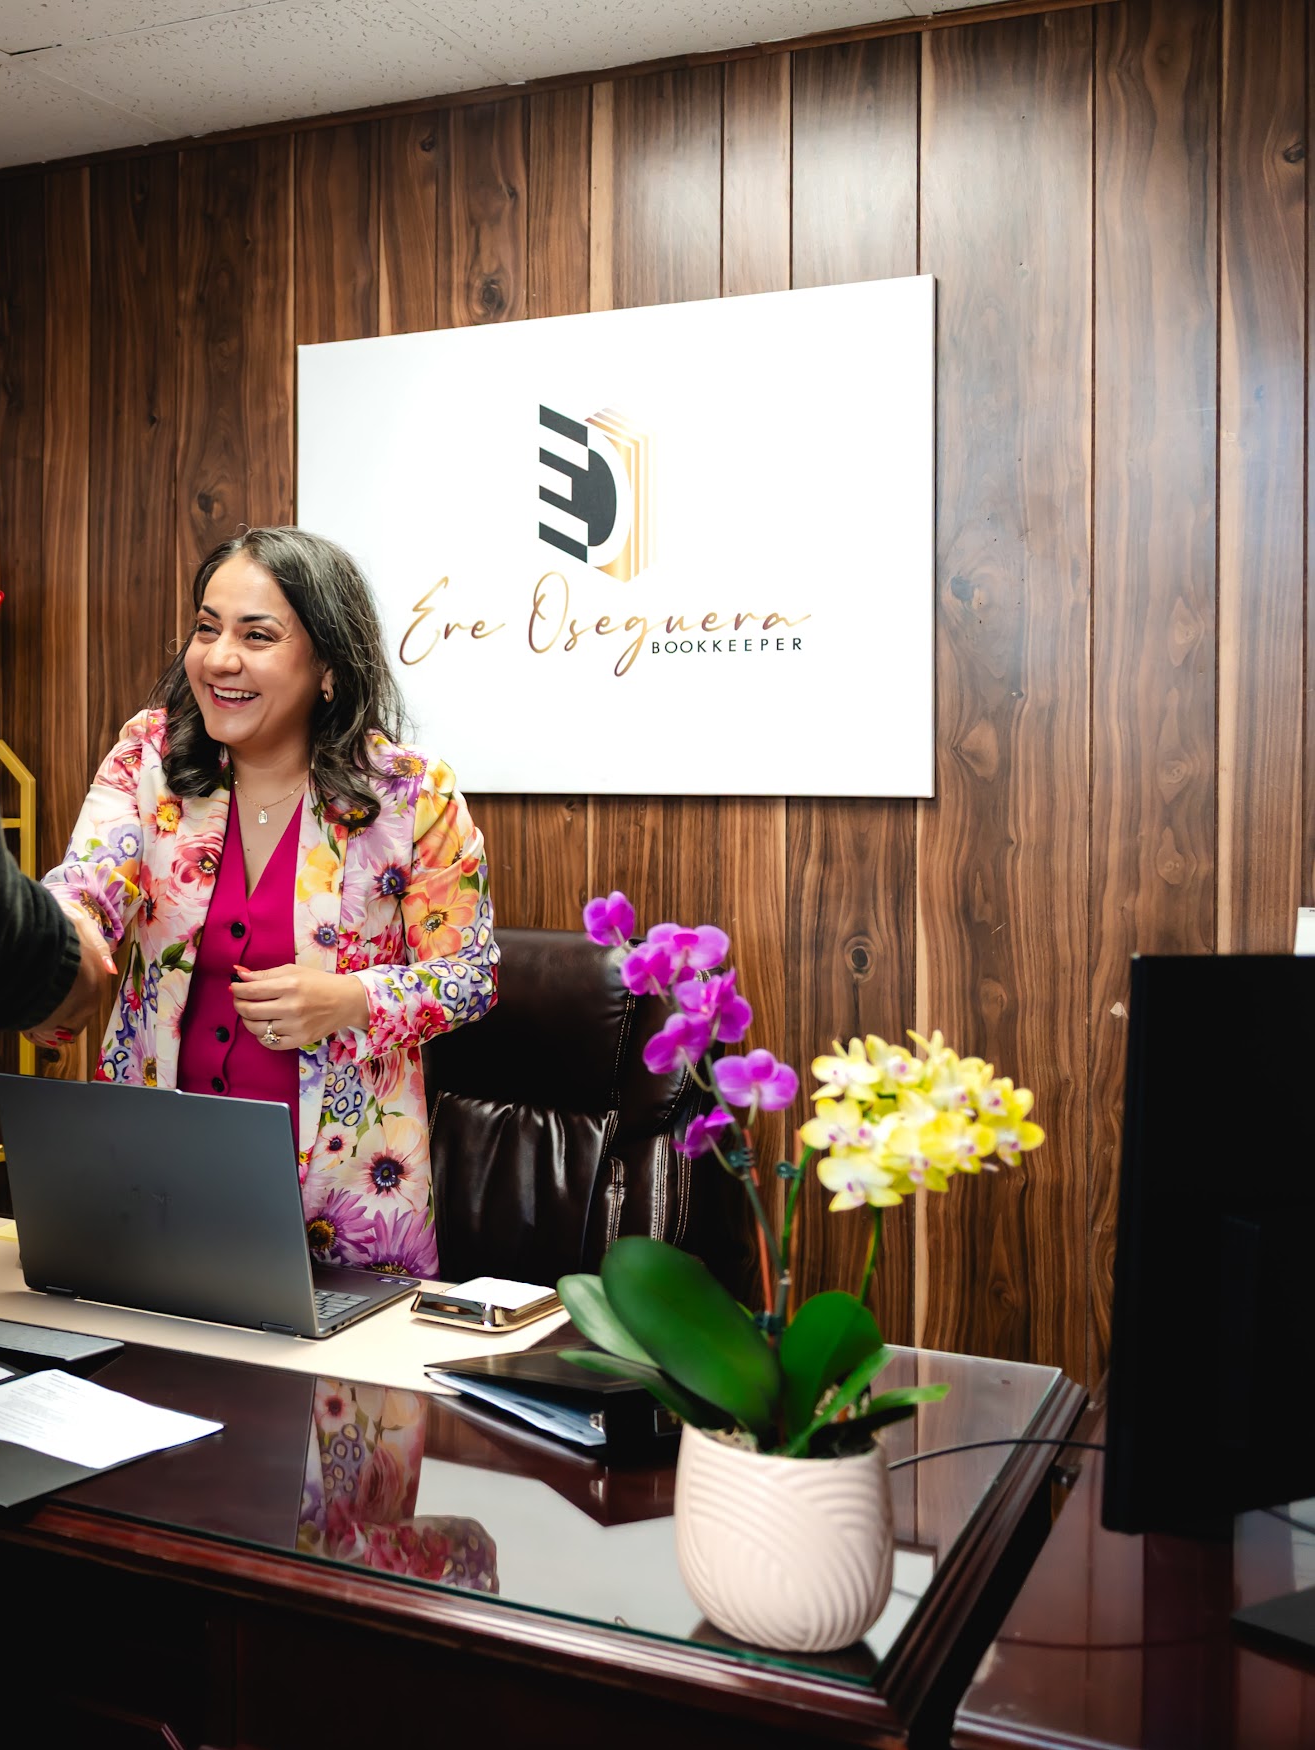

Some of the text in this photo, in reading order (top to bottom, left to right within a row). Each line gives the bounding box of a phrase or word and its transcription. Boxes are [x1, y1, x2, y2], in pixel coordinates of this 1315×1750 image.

[399, 571, 811, 679] Ere Oseguera
[651, 638, 804, 655] BOOKKEEPER
